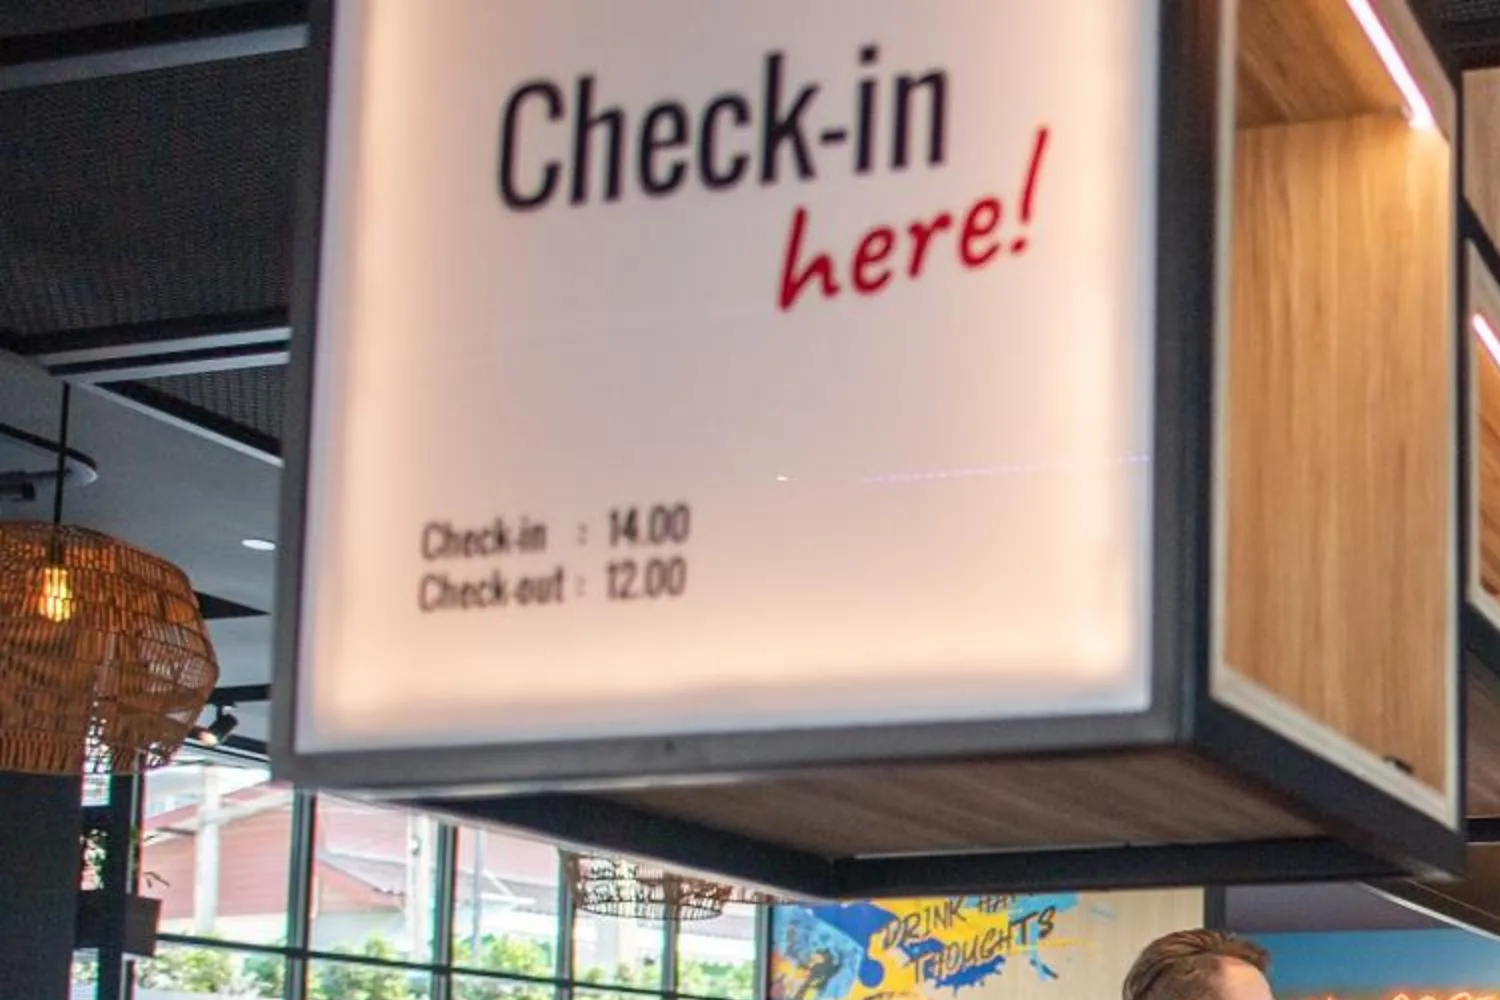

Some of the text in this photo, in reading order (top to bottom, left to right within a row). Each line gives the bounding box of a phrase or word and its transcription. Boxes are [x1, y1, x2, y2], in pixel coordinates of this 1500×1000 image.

[498, 43, 949, 213] Check-in
[776, 126, 1050, 312] here!
[421, 515, 547, 562] Check-in
[608, 502, 691, 547] 14.00
[417, 565, 564, 614] Check-out
[606, 554, 687, 600] 12.00
[883, 894, 967, 951] DRINK
[903, 905, 1057, 984] THOUGHTS
